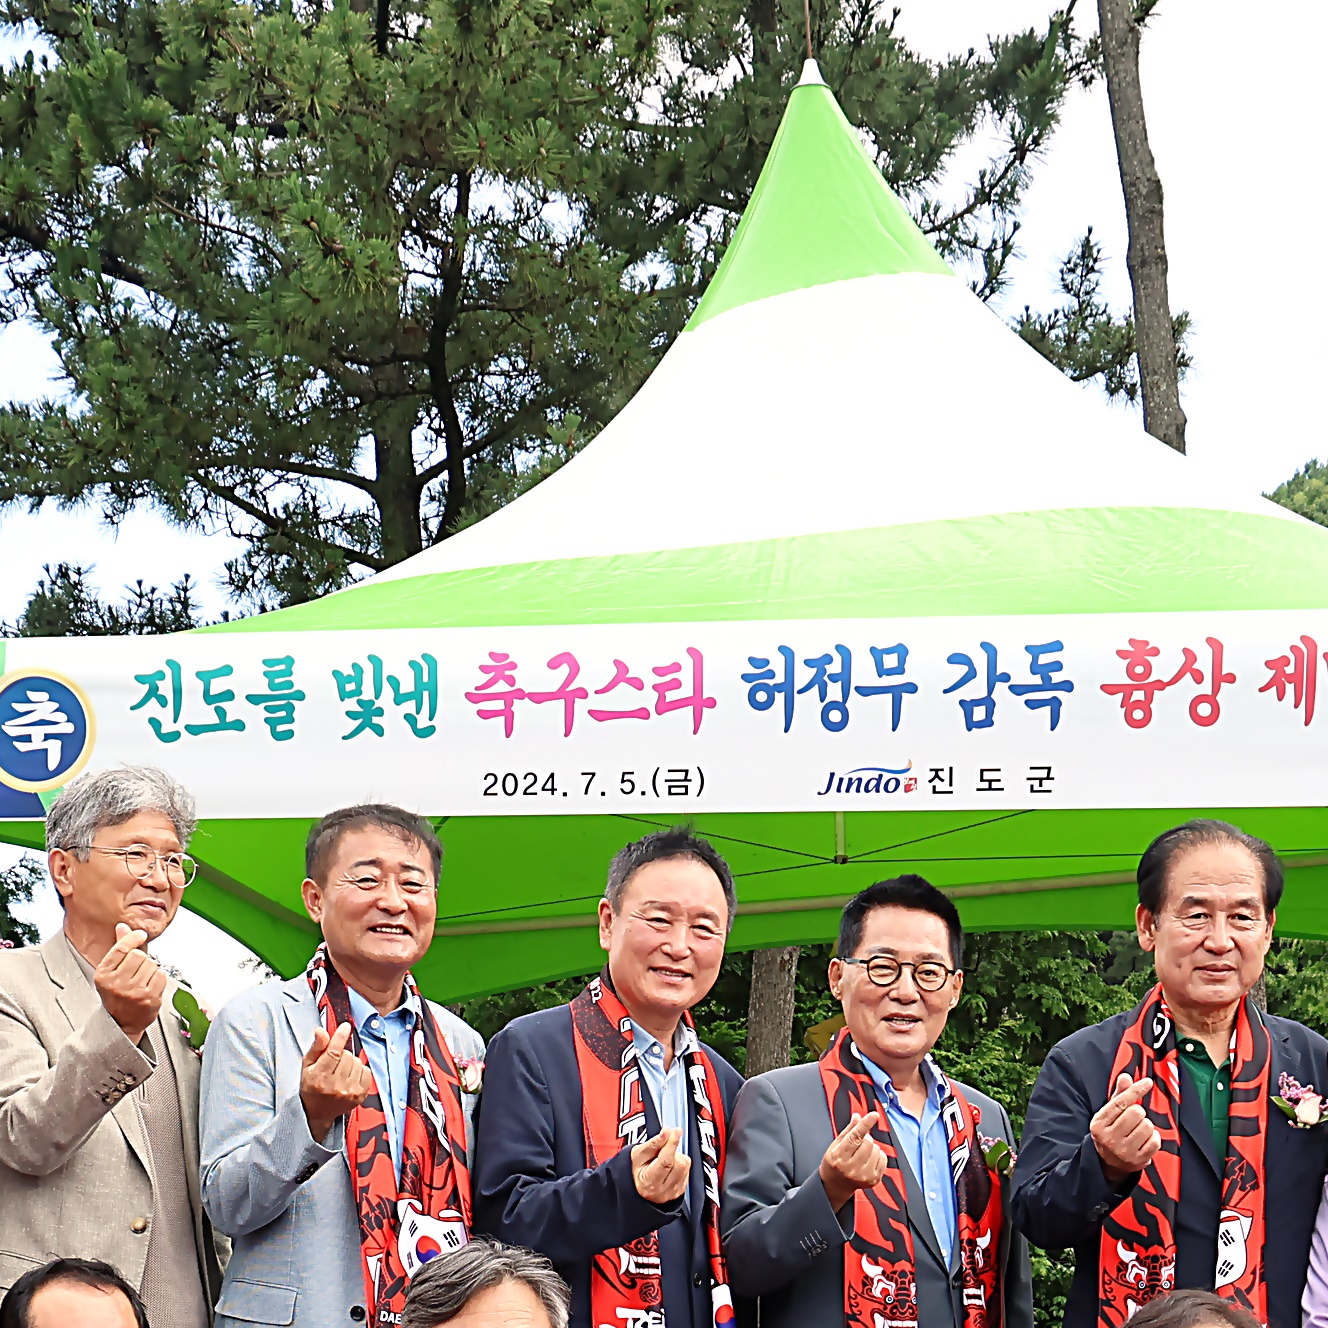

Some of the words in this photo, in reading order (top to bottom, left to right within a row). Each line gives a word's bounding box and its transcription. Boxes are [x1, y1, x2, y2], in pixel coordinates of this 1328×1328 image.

[130, 655, 306, 743] 진도를
[331, 653, 439, 741] 빛낸
[464, 646, 717, 739] 축구스타
[740, 643, 919, 734] 허정무
[942, 640, 1075, 732] 감독
[1099, 637, 1237, 729] 흉상
[0, 689, 76, 772] 축
[482, 771, 570, 798] 2024.
[580, 771, 608, 797] 7.
[816, 769, 903, 797] Jindo
